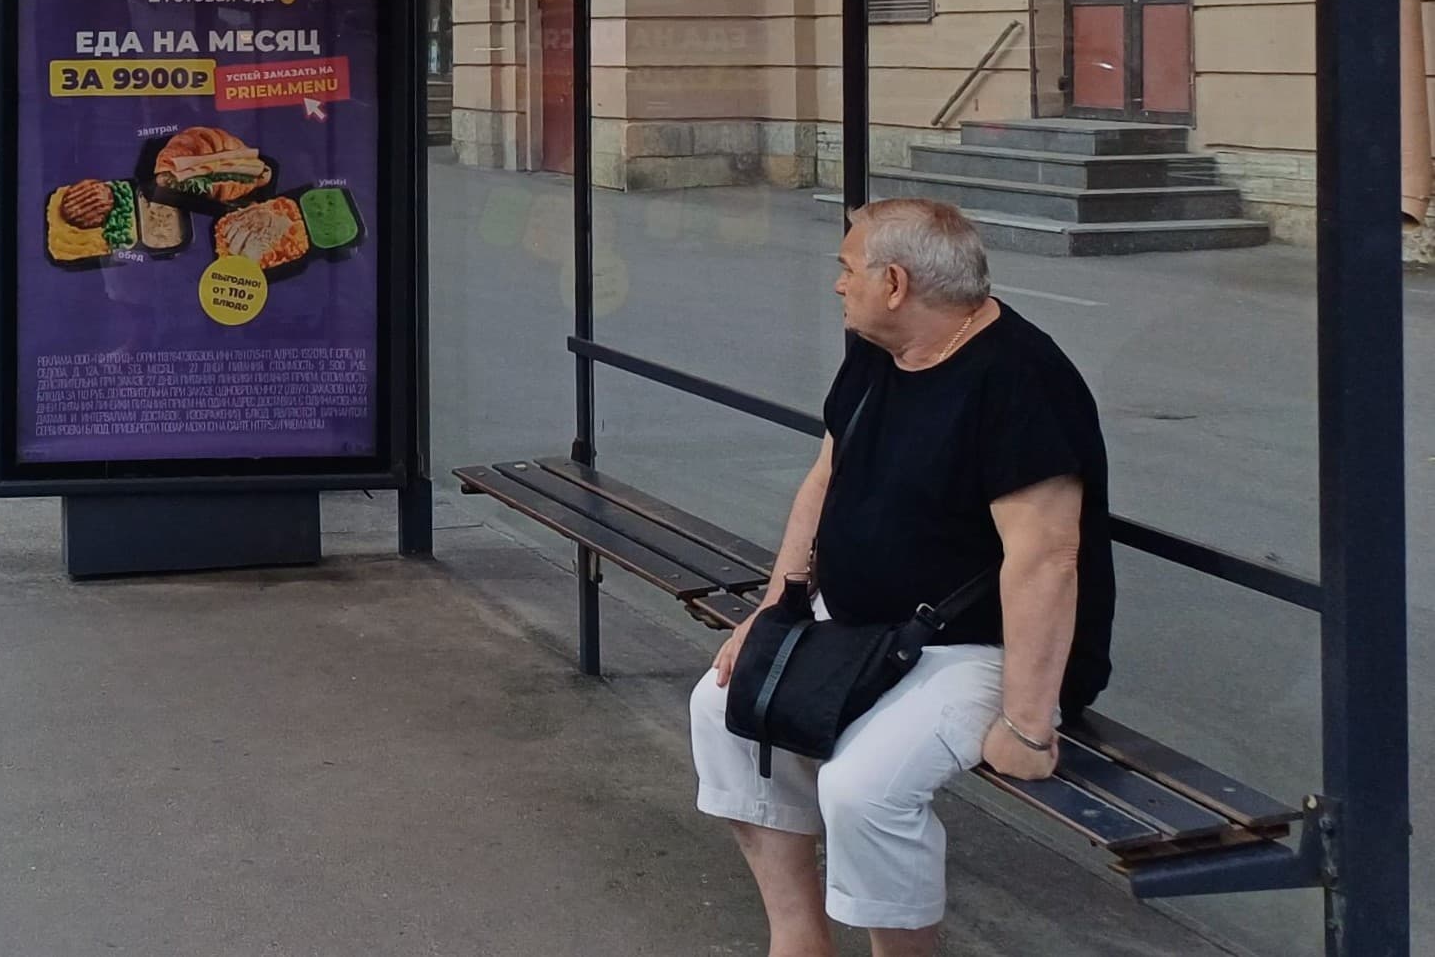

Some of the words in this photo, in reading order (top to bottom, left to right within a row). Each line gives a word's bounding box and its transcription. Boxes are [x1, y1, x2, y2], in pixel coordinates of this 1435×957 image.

[76, 31, 144, 56] ЕДА
[153, 31, 199, 53] НА
[209, 30, 321, 55] МЕСЯЦ
[61, 68, 103, 90] ЗА
[226, 70, 261, 82] УСПЕЙ
[264, 67, 317, 79] ЗАКАЗАТЬ
[319, 65, 334, 74] НА
[225, 79, 338, 99] PRIEM.MENU
[137, 124, 178, 136] завтрак
[318, 178, 347, 187] ужин
[118, 251, 144, 262] обед
[212, 286, 225, 295] ОТ
[212, 297, 249, 311] БЛЮДО
